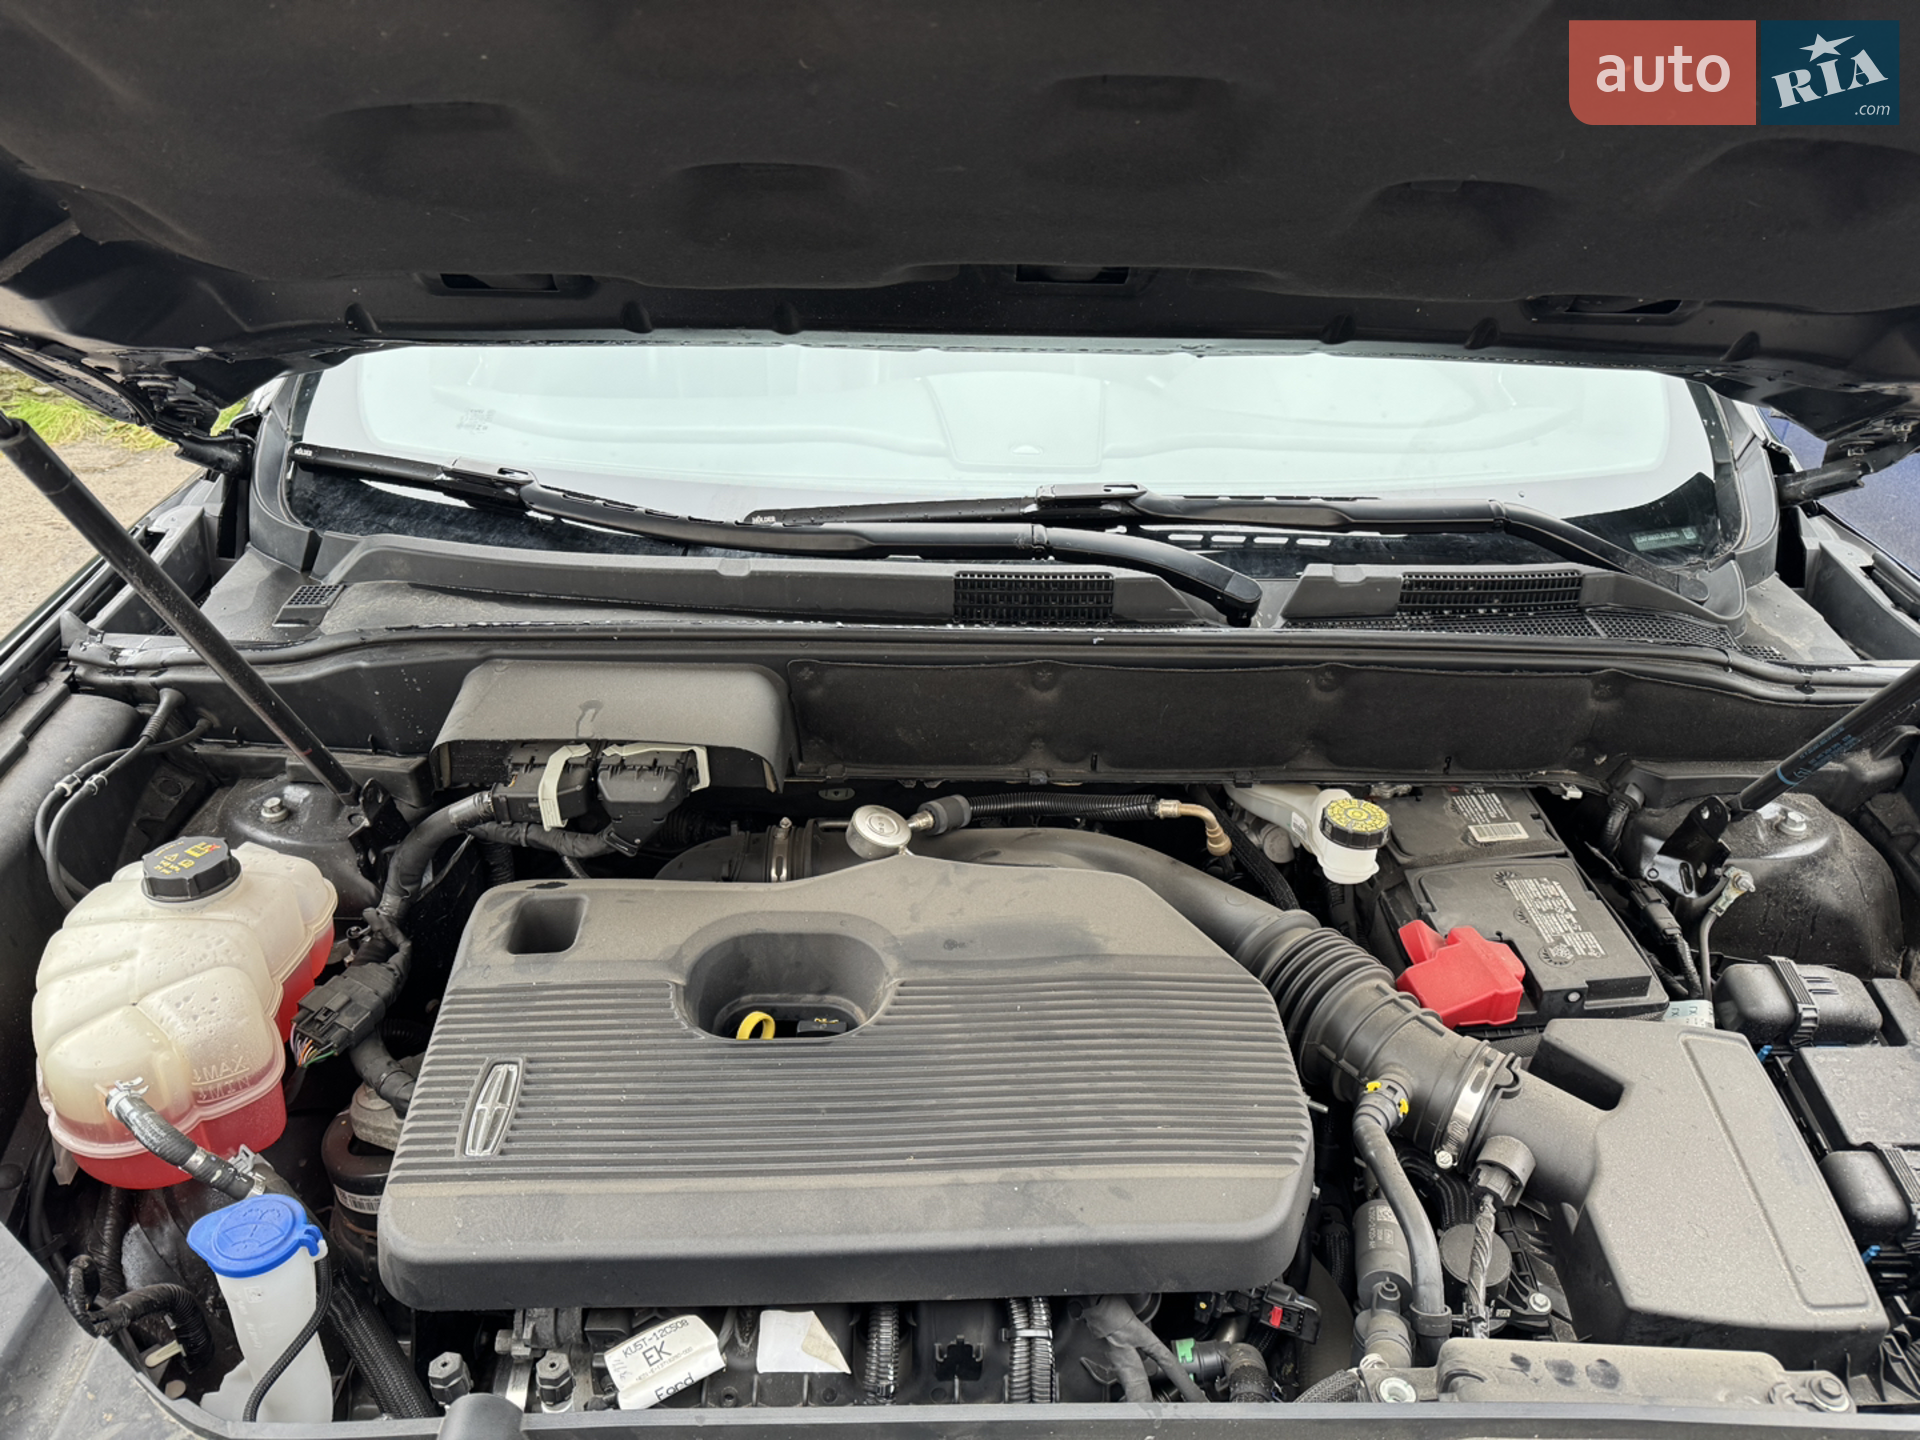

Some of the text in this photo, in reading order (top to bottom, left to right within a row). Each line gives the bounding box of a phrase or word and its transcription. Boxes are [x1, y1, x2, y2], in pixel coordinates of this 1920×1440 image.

[203, 1055, 246, 1081] MAX
[208, 1074, 251, 1099] MIN
[642, 1340, 672, 1368] EK
[654, 1372, 695, 1401] Ford
